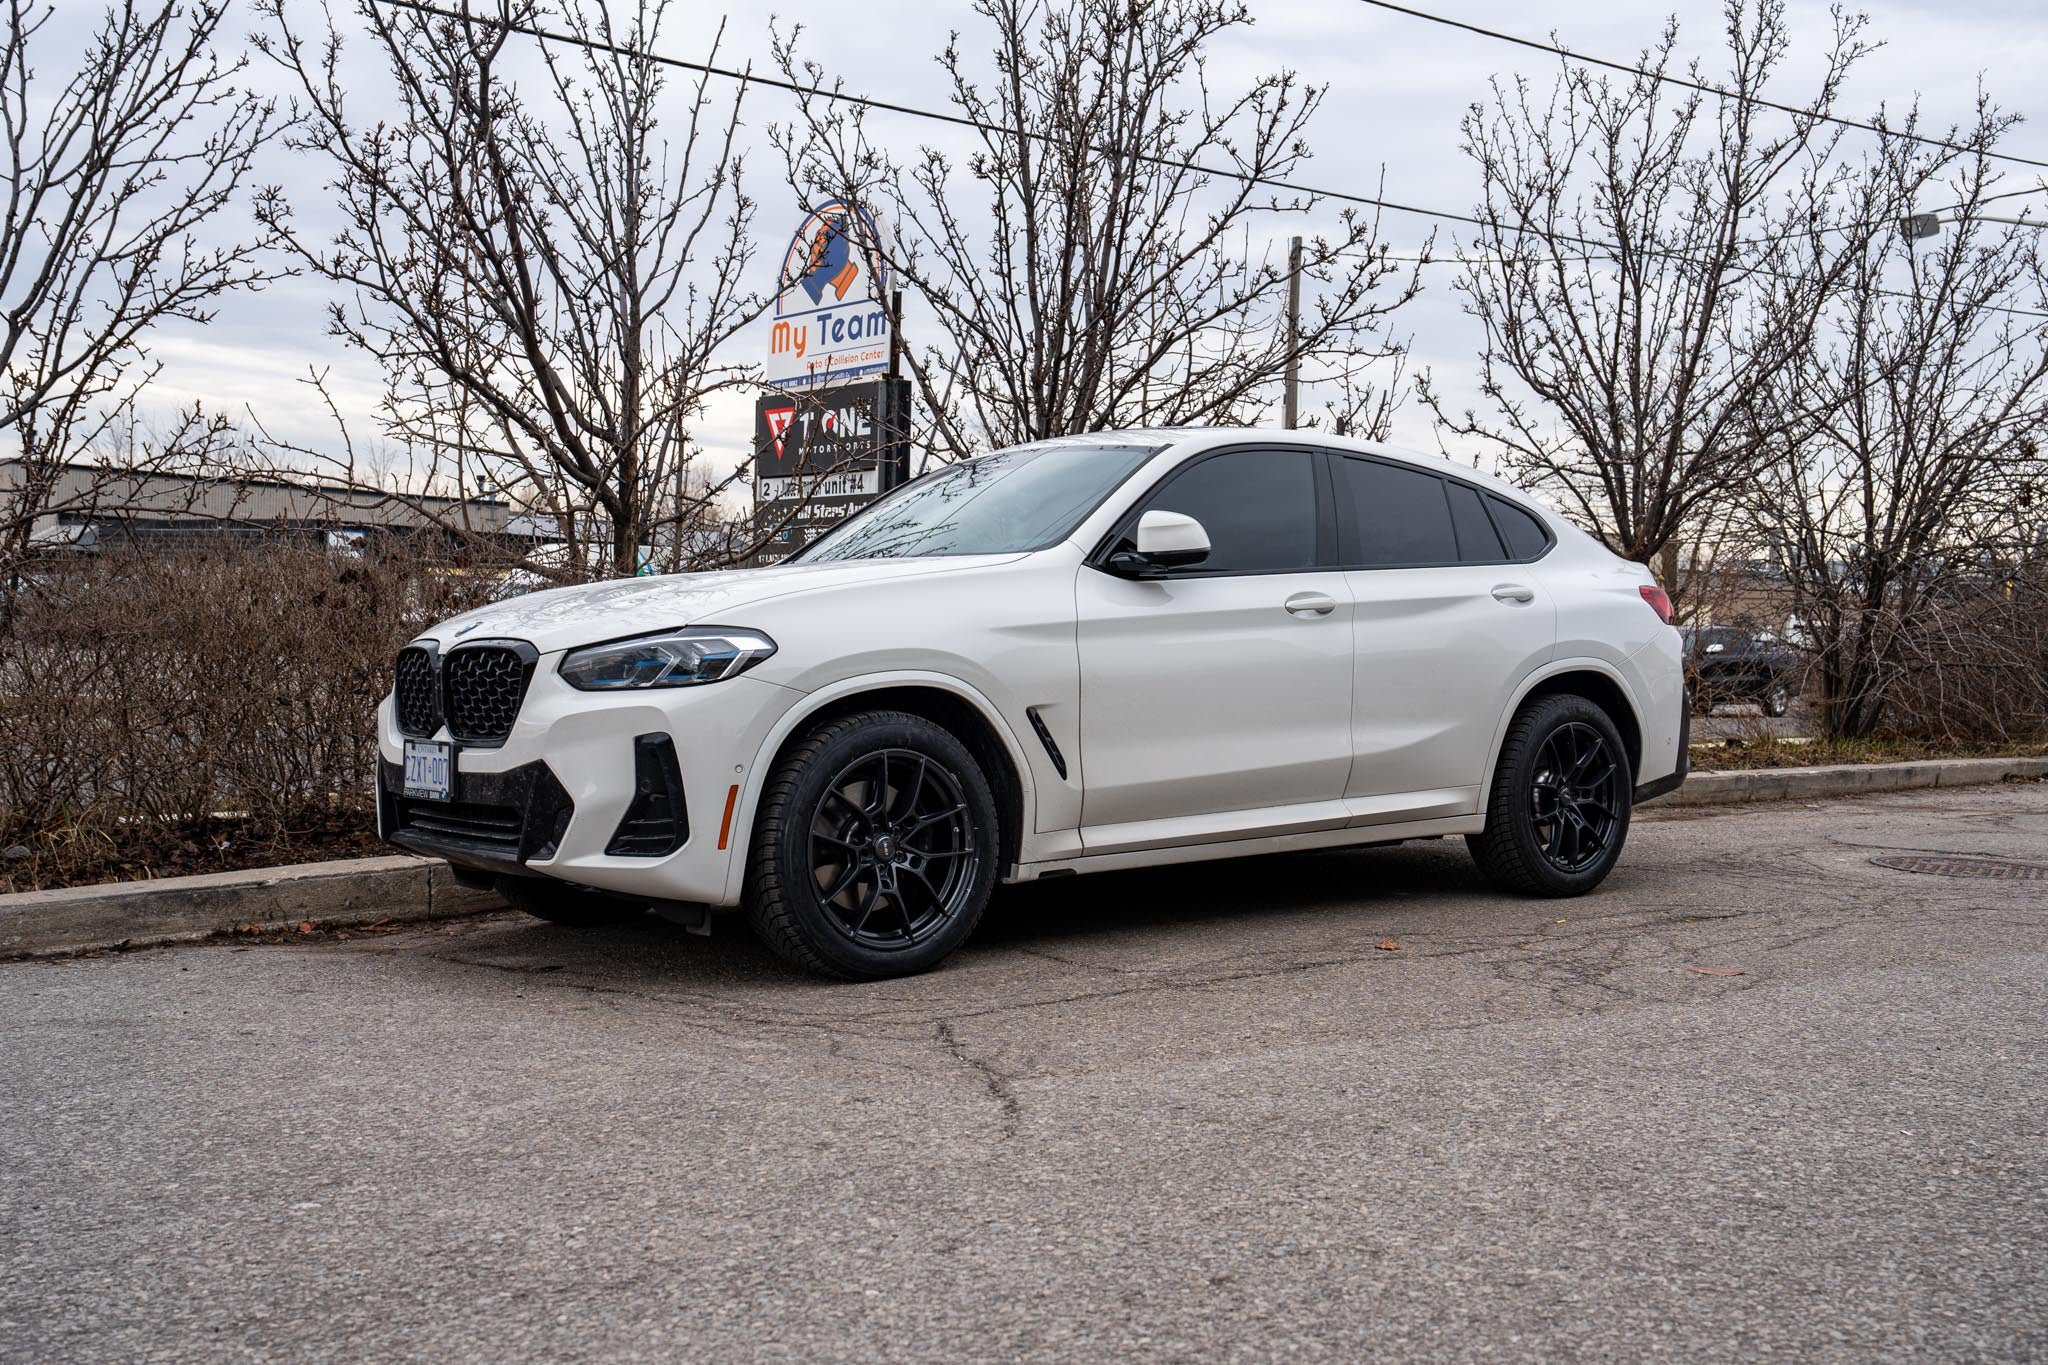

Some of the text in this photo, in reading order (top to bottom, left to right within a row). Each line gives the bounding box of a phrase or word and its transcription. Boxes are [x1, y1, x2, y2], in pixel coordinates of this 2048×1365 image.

[771, 310, 886, 358] My Team
[806, 359, 823, 369] Ato
[831, 353, 859, 367] Collision
[861, 350, 885, 361] Center
[798, 441, 871, 455] MTORSORTS
[763, 482, 771, 497] 2
[824, 477, 847, 495] unit
[850, 474, 864, 493] #4
[404, 788, 440, 799] PARKVIEW BMW
